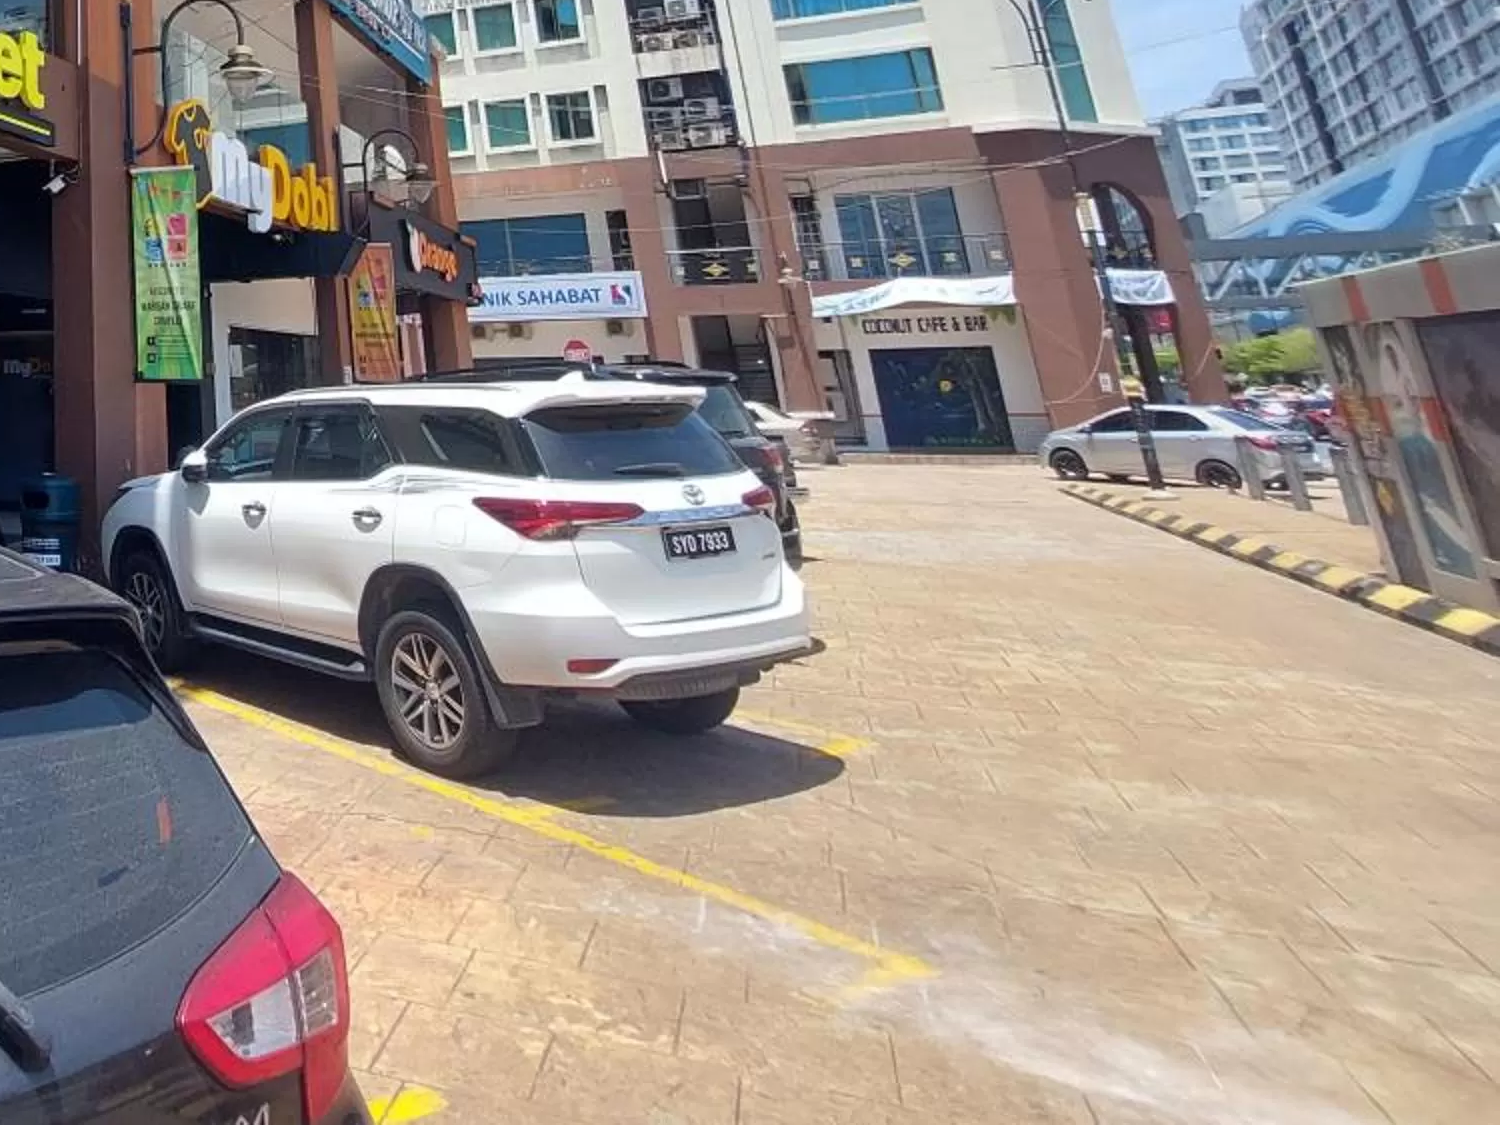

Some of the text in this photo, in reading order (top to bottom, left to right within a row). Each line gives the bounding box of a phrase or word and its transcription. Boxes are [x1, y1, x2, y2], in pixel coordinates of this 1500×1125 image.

[481, 288, 603, 308] NIK SAHABAT
[861, 315, 989, 335] COCONUT CAFE & BAR
